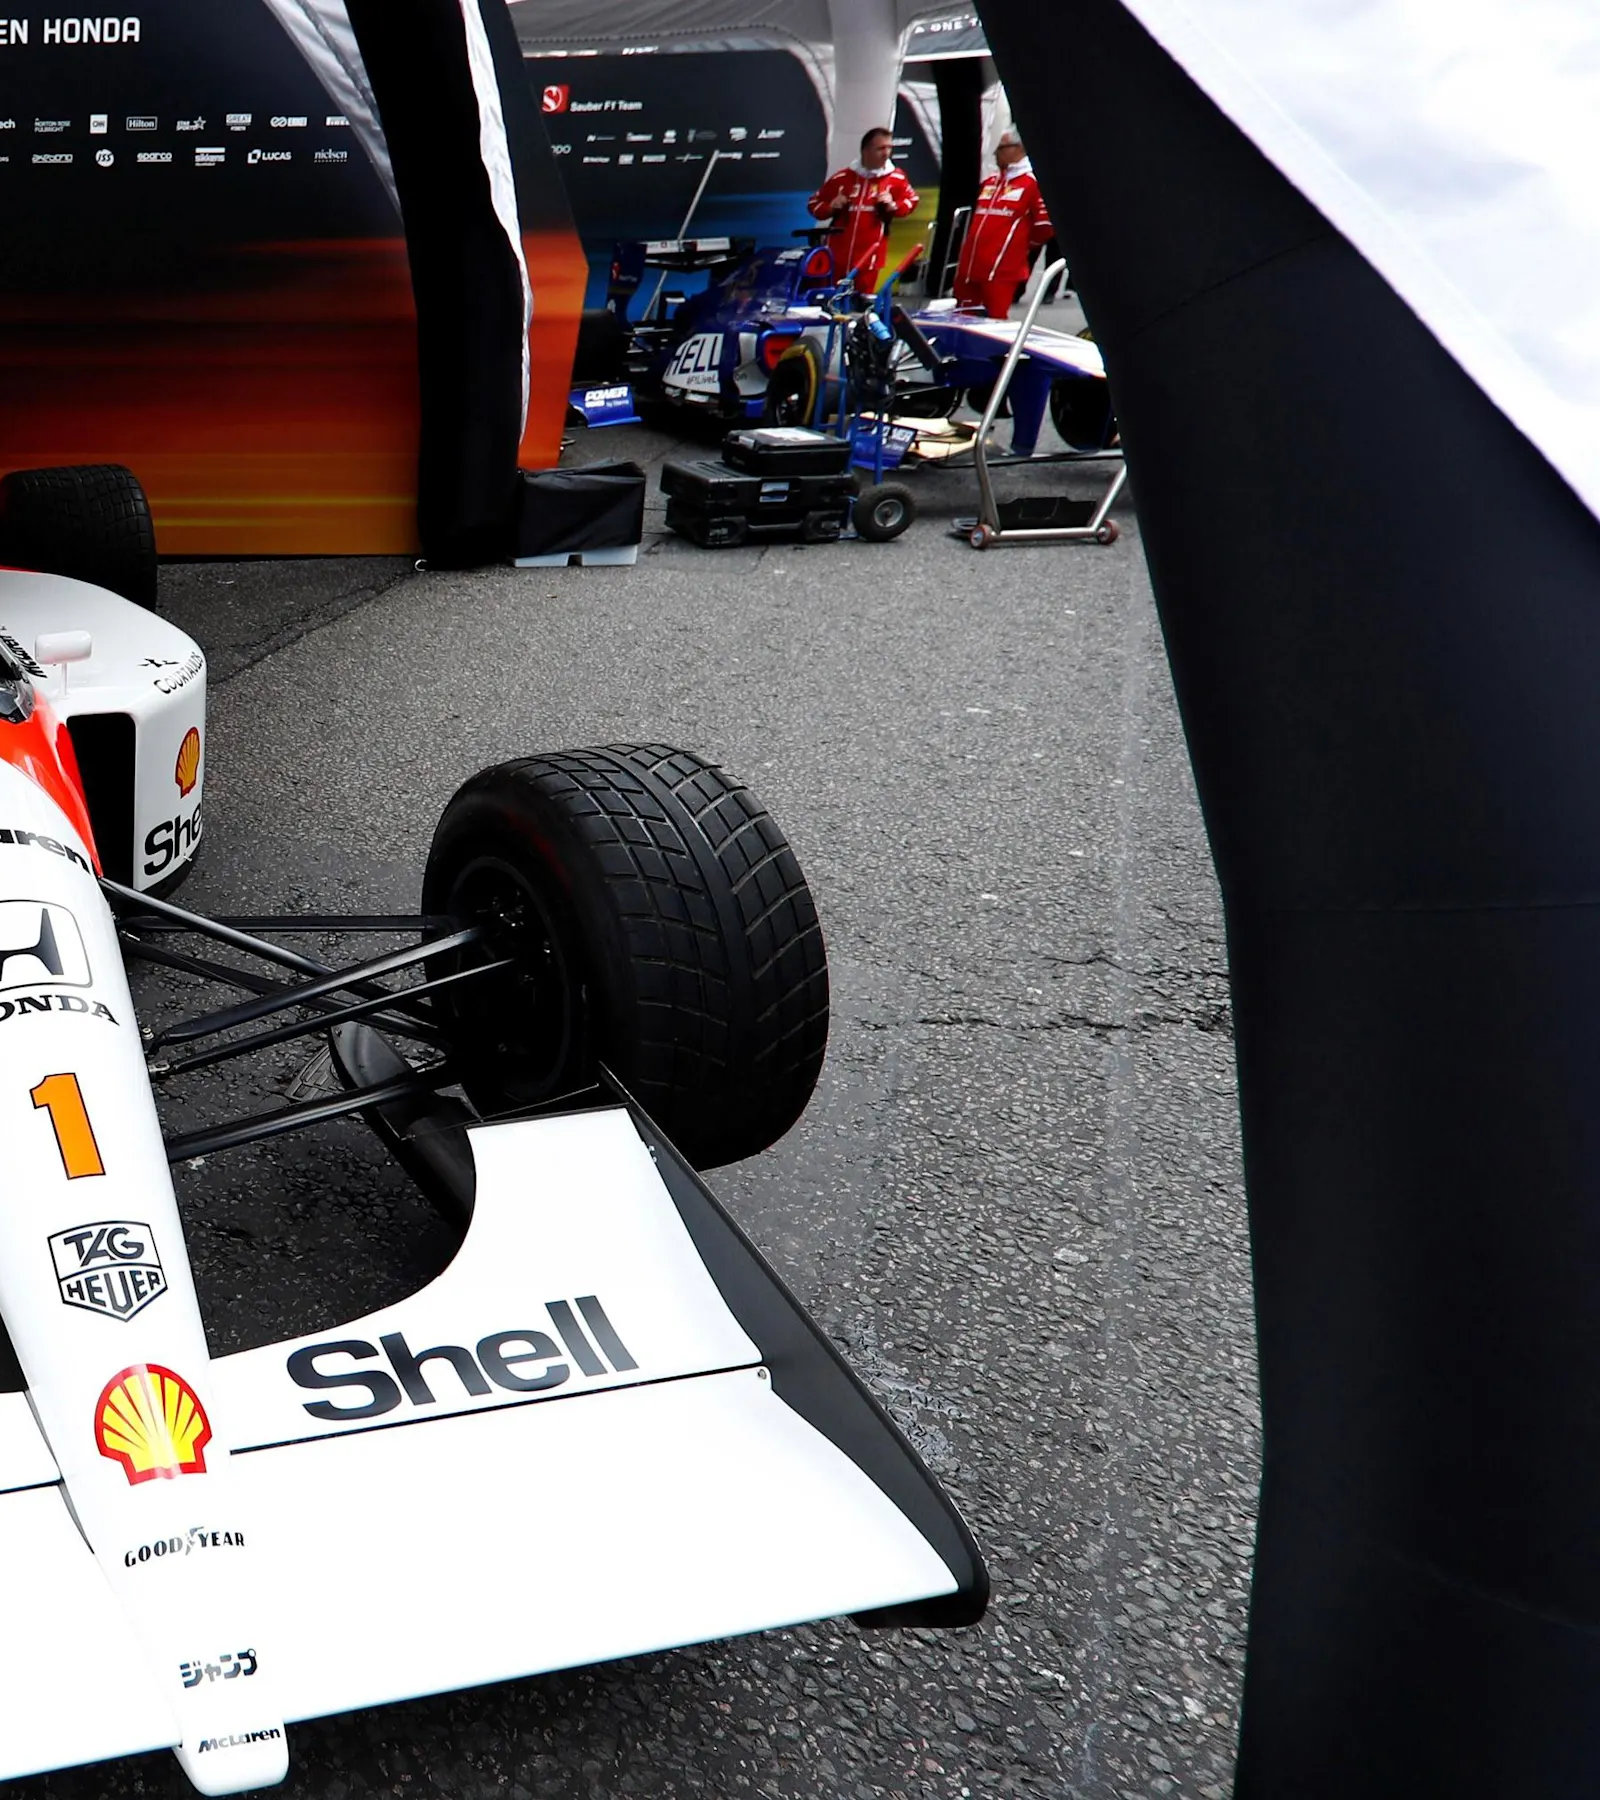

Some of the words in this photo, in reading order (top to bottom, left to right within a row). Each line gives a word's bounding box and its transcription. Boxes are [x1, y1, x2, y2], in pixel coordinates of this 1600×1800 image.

[43, 17, 140, 44] HONDA
[570, 102, 602, 112] Sauber
[603, 101, 615, 111] F1
[618, 101, 642, 111] Team
[128, 119, 155, 129] Hilton
[137, 152, 173, 160] sparco
[262, 152, 292, 161] LUCAS
[314, 149, 347, 159] nielsen
[585, 386, 629, 401] POWER
[29, 1072, 106, 1180] 1
[63, 1227, 145, 1267] TAG
[67, 1270, 160, 1314] HEUER
[286, 1295, 639, 1420] Shell
[179, 1648, 258, 1688] ジャンプ
[198, 1727, 280, 1754] McLaren
